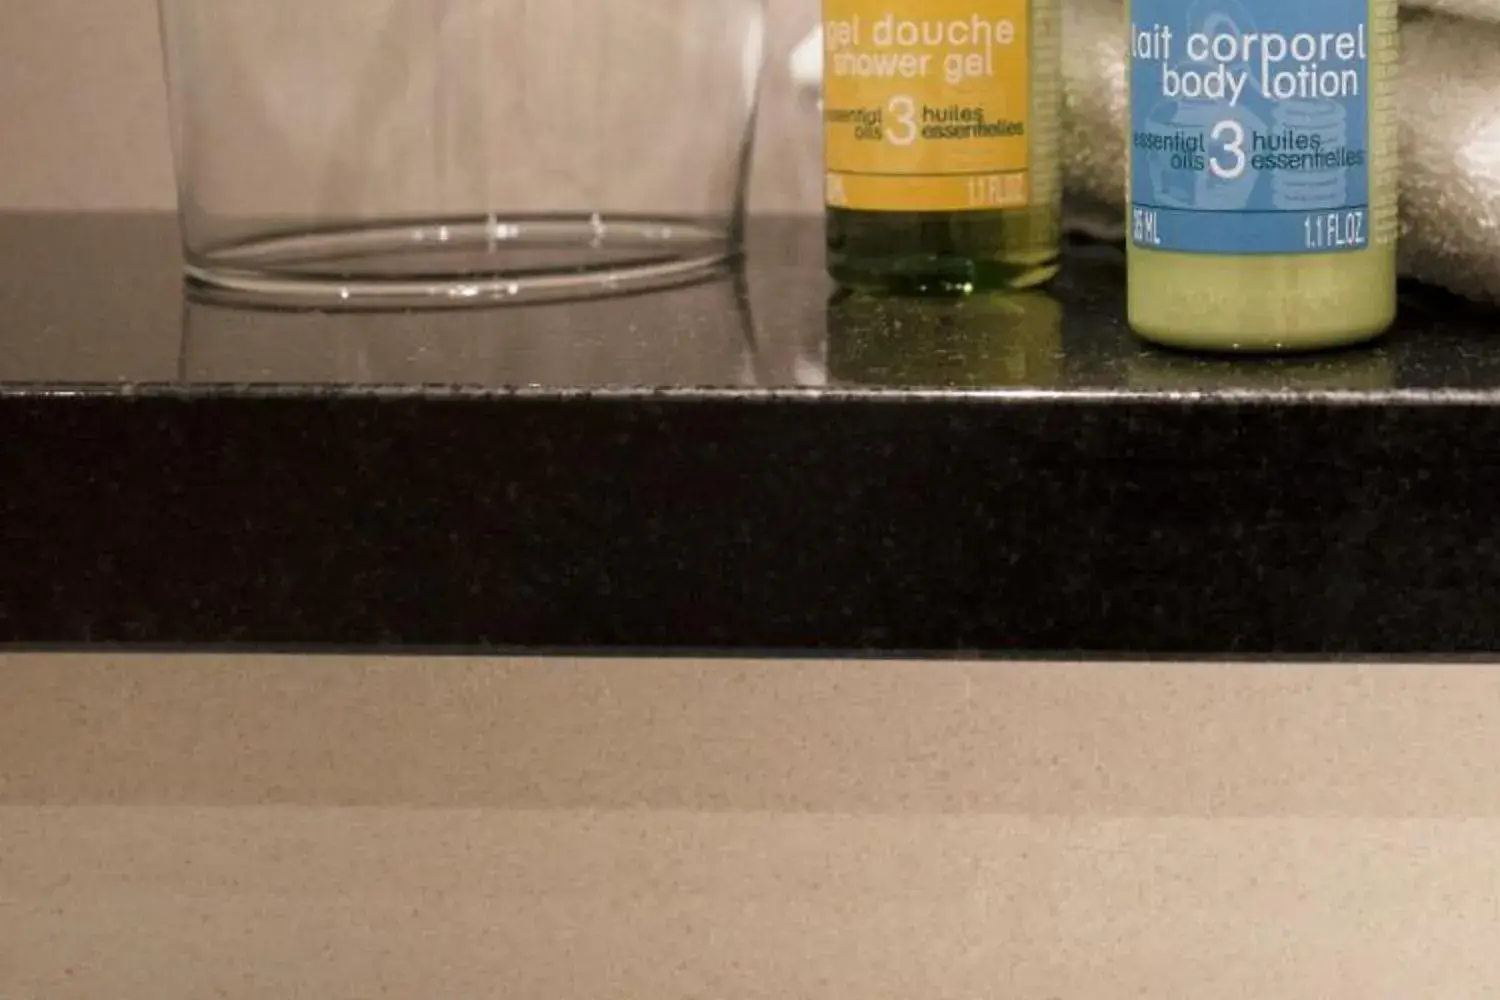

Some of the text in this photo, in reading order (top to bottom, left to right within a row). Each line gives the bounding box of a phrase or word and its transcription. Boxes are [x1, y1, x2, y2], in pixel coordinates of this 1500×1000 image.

[872, 10, 1015, 47] douche
[1132, 23, 1366, 75] lait corporel
[833, 47, 994, 84] shower gel
[1163, 62, 1358, 107] body lotion
[829, 94, 984, 146] ntial 3 huiles
[1134, 120, 1321, 179] essential 3 huiles
[1170, 146, 1365, 171] oils essentielles
[1304, 213, 1323, 248] 1.1
